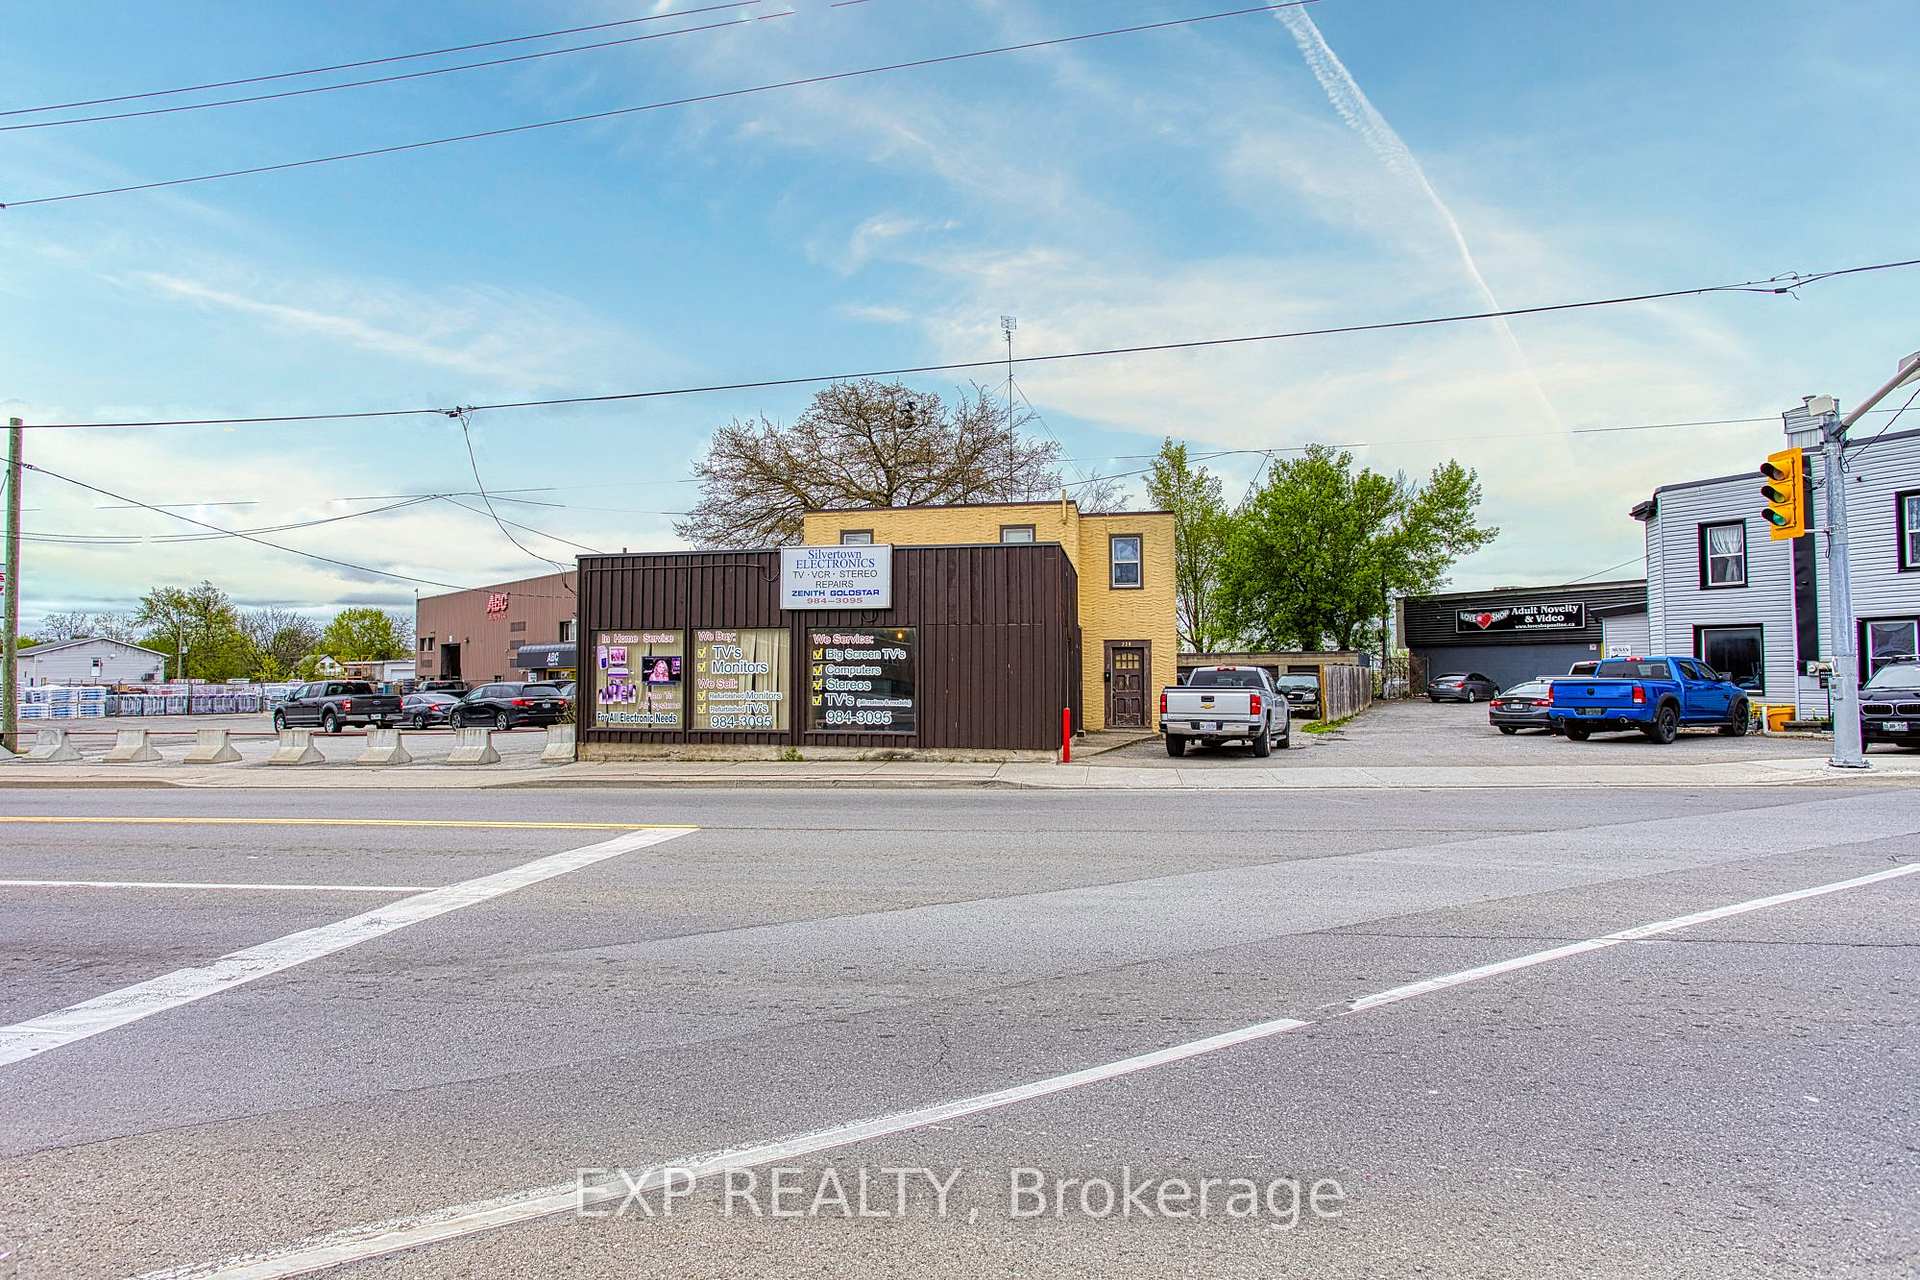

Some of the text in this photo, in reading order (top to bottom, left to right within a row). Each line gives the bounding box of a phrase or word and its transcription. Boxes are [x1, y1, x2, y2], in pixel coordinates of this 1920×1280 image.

[808, 549, 862, 559] Silvertown
[796, 558, 875, 569] ELECTRONICS
[793, 569, 878, 578] TV VCR STEREO
[816, 580, 854, 588] REPAIRS
[791, 589, 880, 597] ZENITH GOLDSTAR
[1511, 604, 1579, 616] Adult Novelty
[1460, 611, 1477, 622] LOVE
[1525, 614, 1565, 623] & Video
[601, 633, 610, 643] In
[613, 633, 639, 643] Home
[698, 631, 737, 642] We Buy:
[812, 633, 875, 644] We Service:
[712, 645, 743, 659] TV's
[826, 648, 906, 661] Big Screen TV's
[712, 660, 769, 674] Monitors
[826, 664, 882, 677] Computers
[697, 678, 738, 689] We Sell:
[826, 678, 872, 690] Stereos
[745, 690, 783, 700] Monitors
[825, 693, 854, 706] TV's
[745, 702, 769, 713] TV's
[597, 712, 608, 722] For
[620, 711, 654, 723] Electronic
[655, 712, 677, 723] Needs
[711, 715, 772, 728] 984-3095
[826, 710, 892, 724] 984-3095
